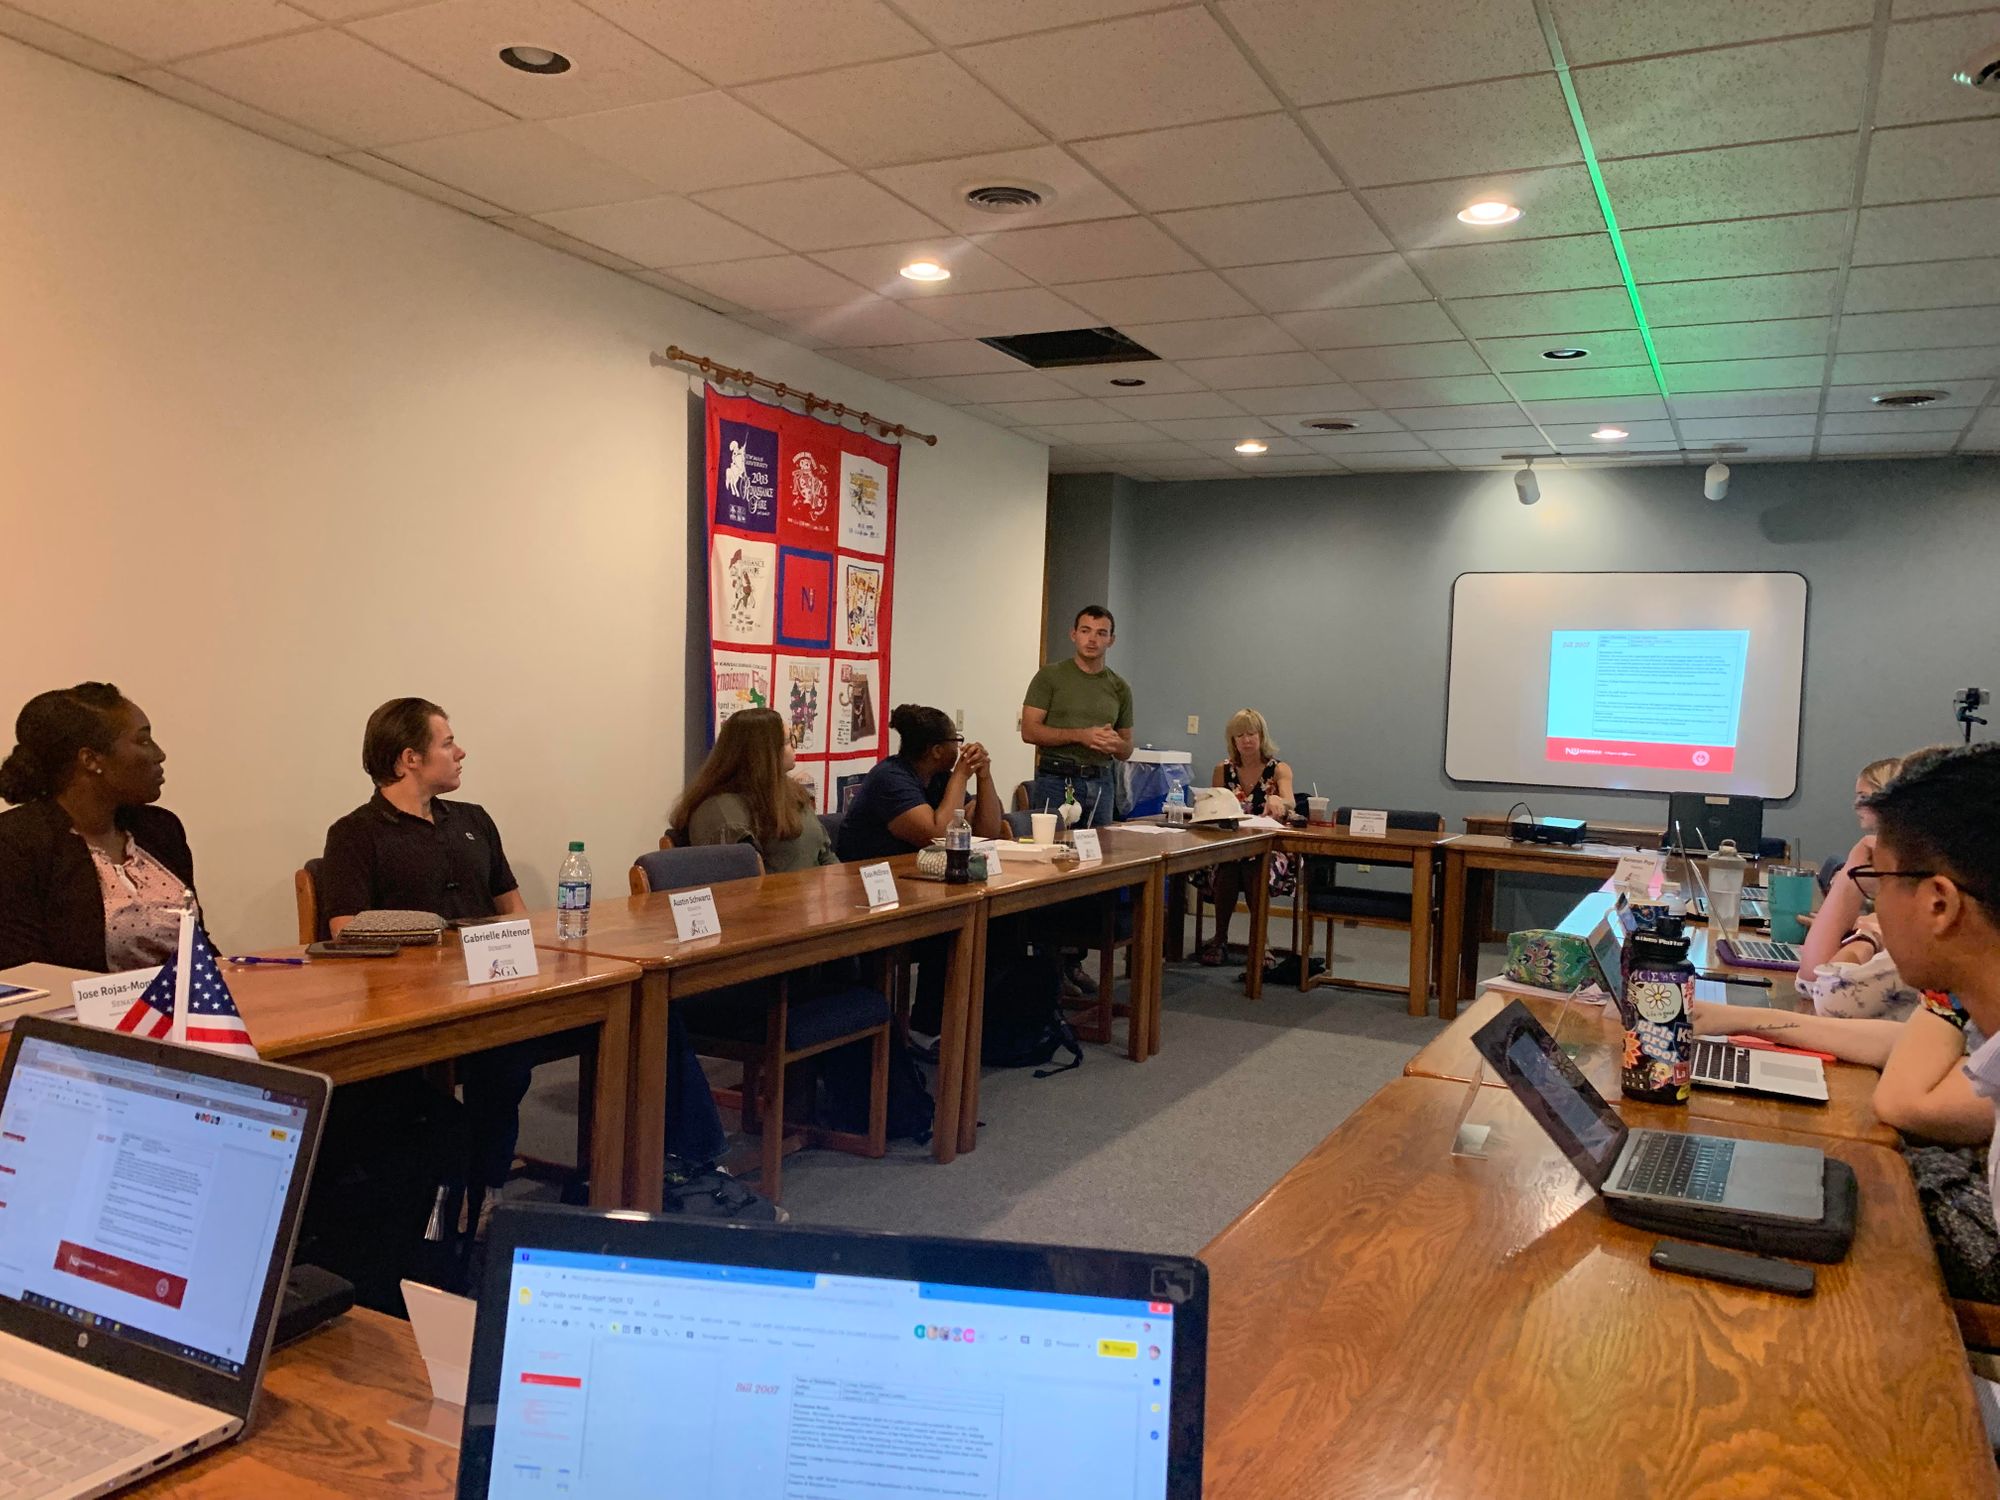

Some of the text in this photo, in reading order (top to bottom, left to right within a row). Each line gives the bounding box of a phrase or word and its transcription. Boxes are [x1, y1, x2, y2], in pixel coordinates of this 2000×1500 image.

[751, 471, 769, 485] 2003
[463, 928, 531, 944] Gabrielle Altenor
[78, 979, 153, 1001] Jose Rojas-Mon
[1642, 1033, 1670, 1049] are
[735, 1381, 753, 1393] Bill
[754, 1383, 780, 1396] 2007
